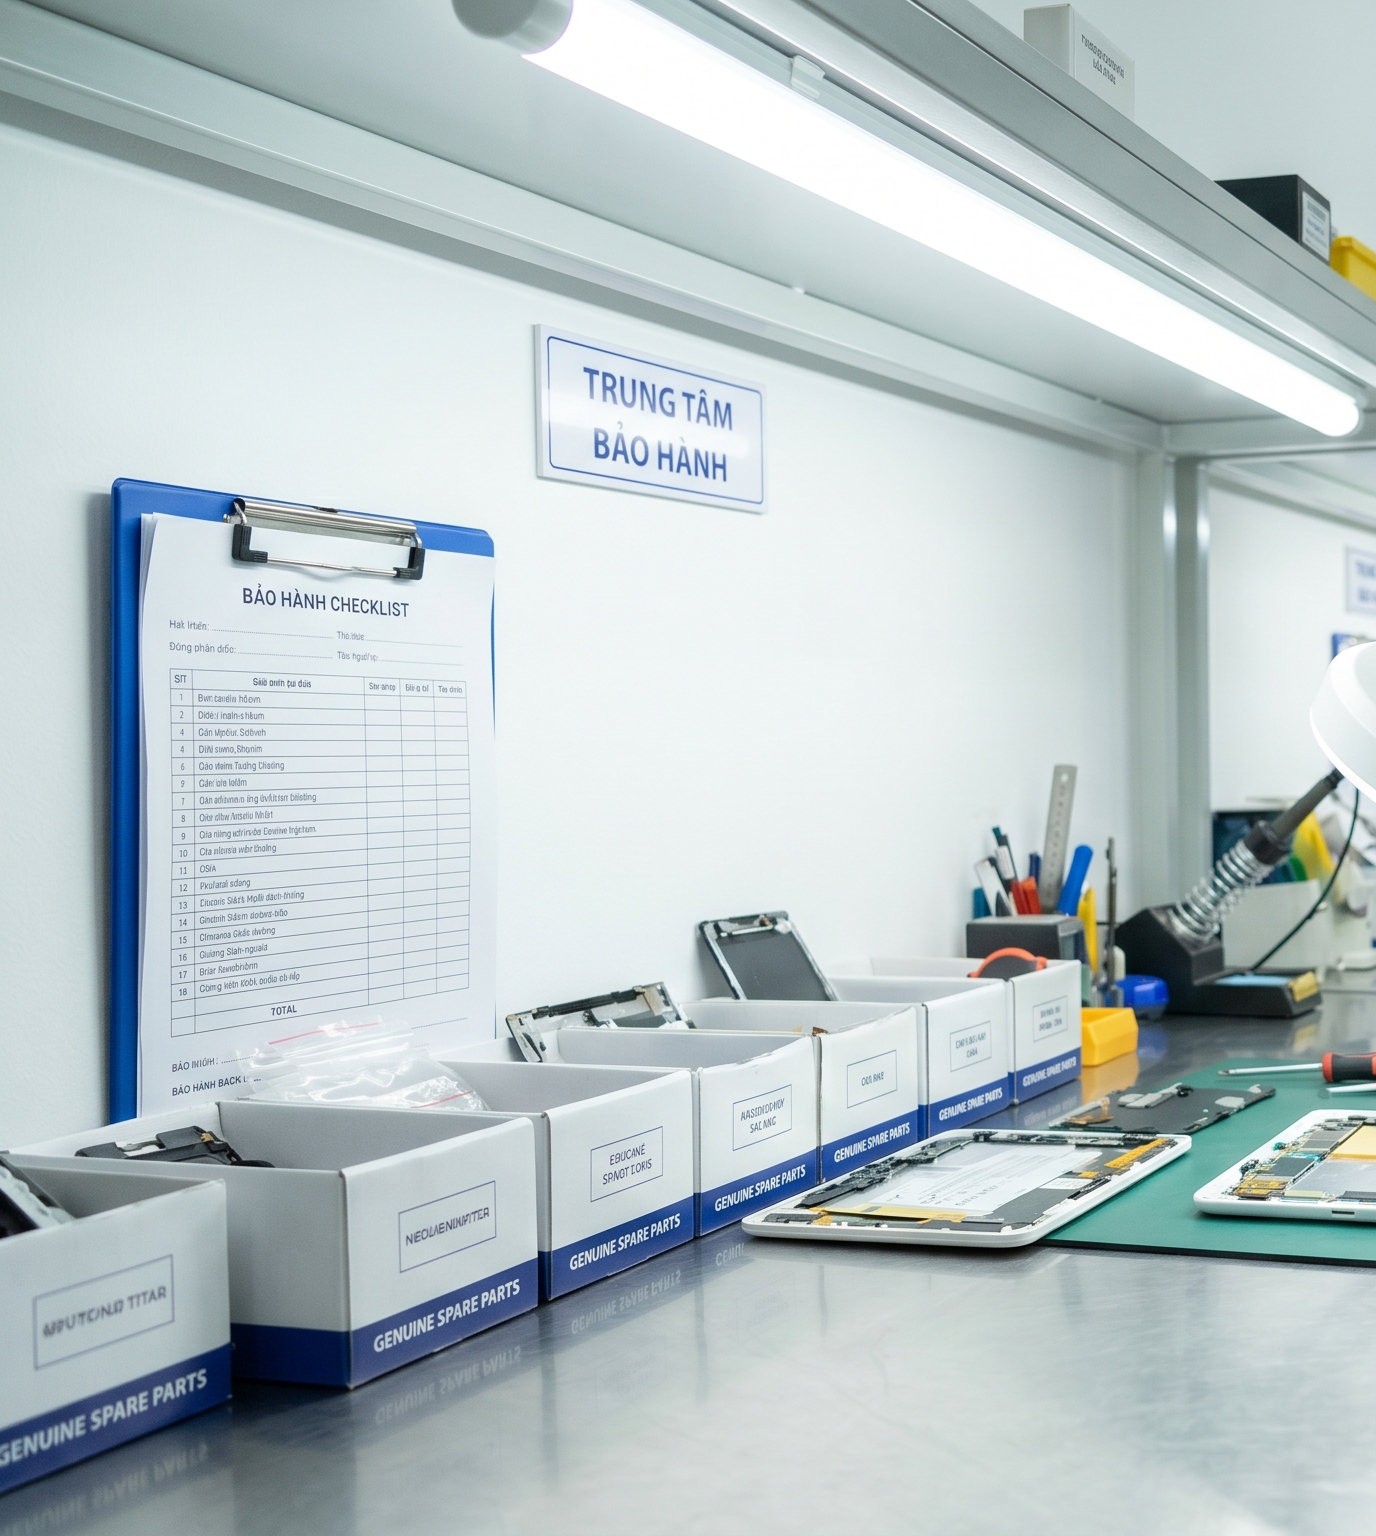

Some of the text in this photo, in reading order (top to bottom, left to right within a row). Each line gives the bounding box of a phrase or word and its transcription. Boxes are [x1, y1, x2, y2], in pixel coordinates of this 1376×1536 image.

[583, 366, 733, 431] TRUNG TÂM
[593, 421, 727, 482] BẢO HÀNH
[242, 583, 409, 617] BẢO HÀNH CHECKLIST
[180, 711, 184, 719] 2
[180, 728, 185, 736] 4
[180, 745, 185, 754] 4
[180, 762, 185, 771] 6
[180, 780, 185, 788] 9
[181, 832, 186, 840] 9
[180, 849, 188, 858] 10
[179, 866, 187, 875] 11
[179, 884, 188, 892] 12
[179, 901, 188, 910] 13
[179, 918, 187, 927] 14
[179, 936, 187, 944] 15
[179, 953, 187, 961] 16
[178, 971, 187, 979] 17
[178, 988, 188, 996] 18
[218, 1075, 242, 1088] BACK
[834, 1122, 910, 1163] GENUINE SPARE PARTS
[714, 1163, 806, 1212] GENUINE SPARE PARTS
[569, 1212, 681, 1271] GENUINE SPARE PARTS
[373, 1278, 521, 1353] GENUINE SPARE PARTS
[0, 1368, 208, 1468] GENUINE SPARE PARTS
